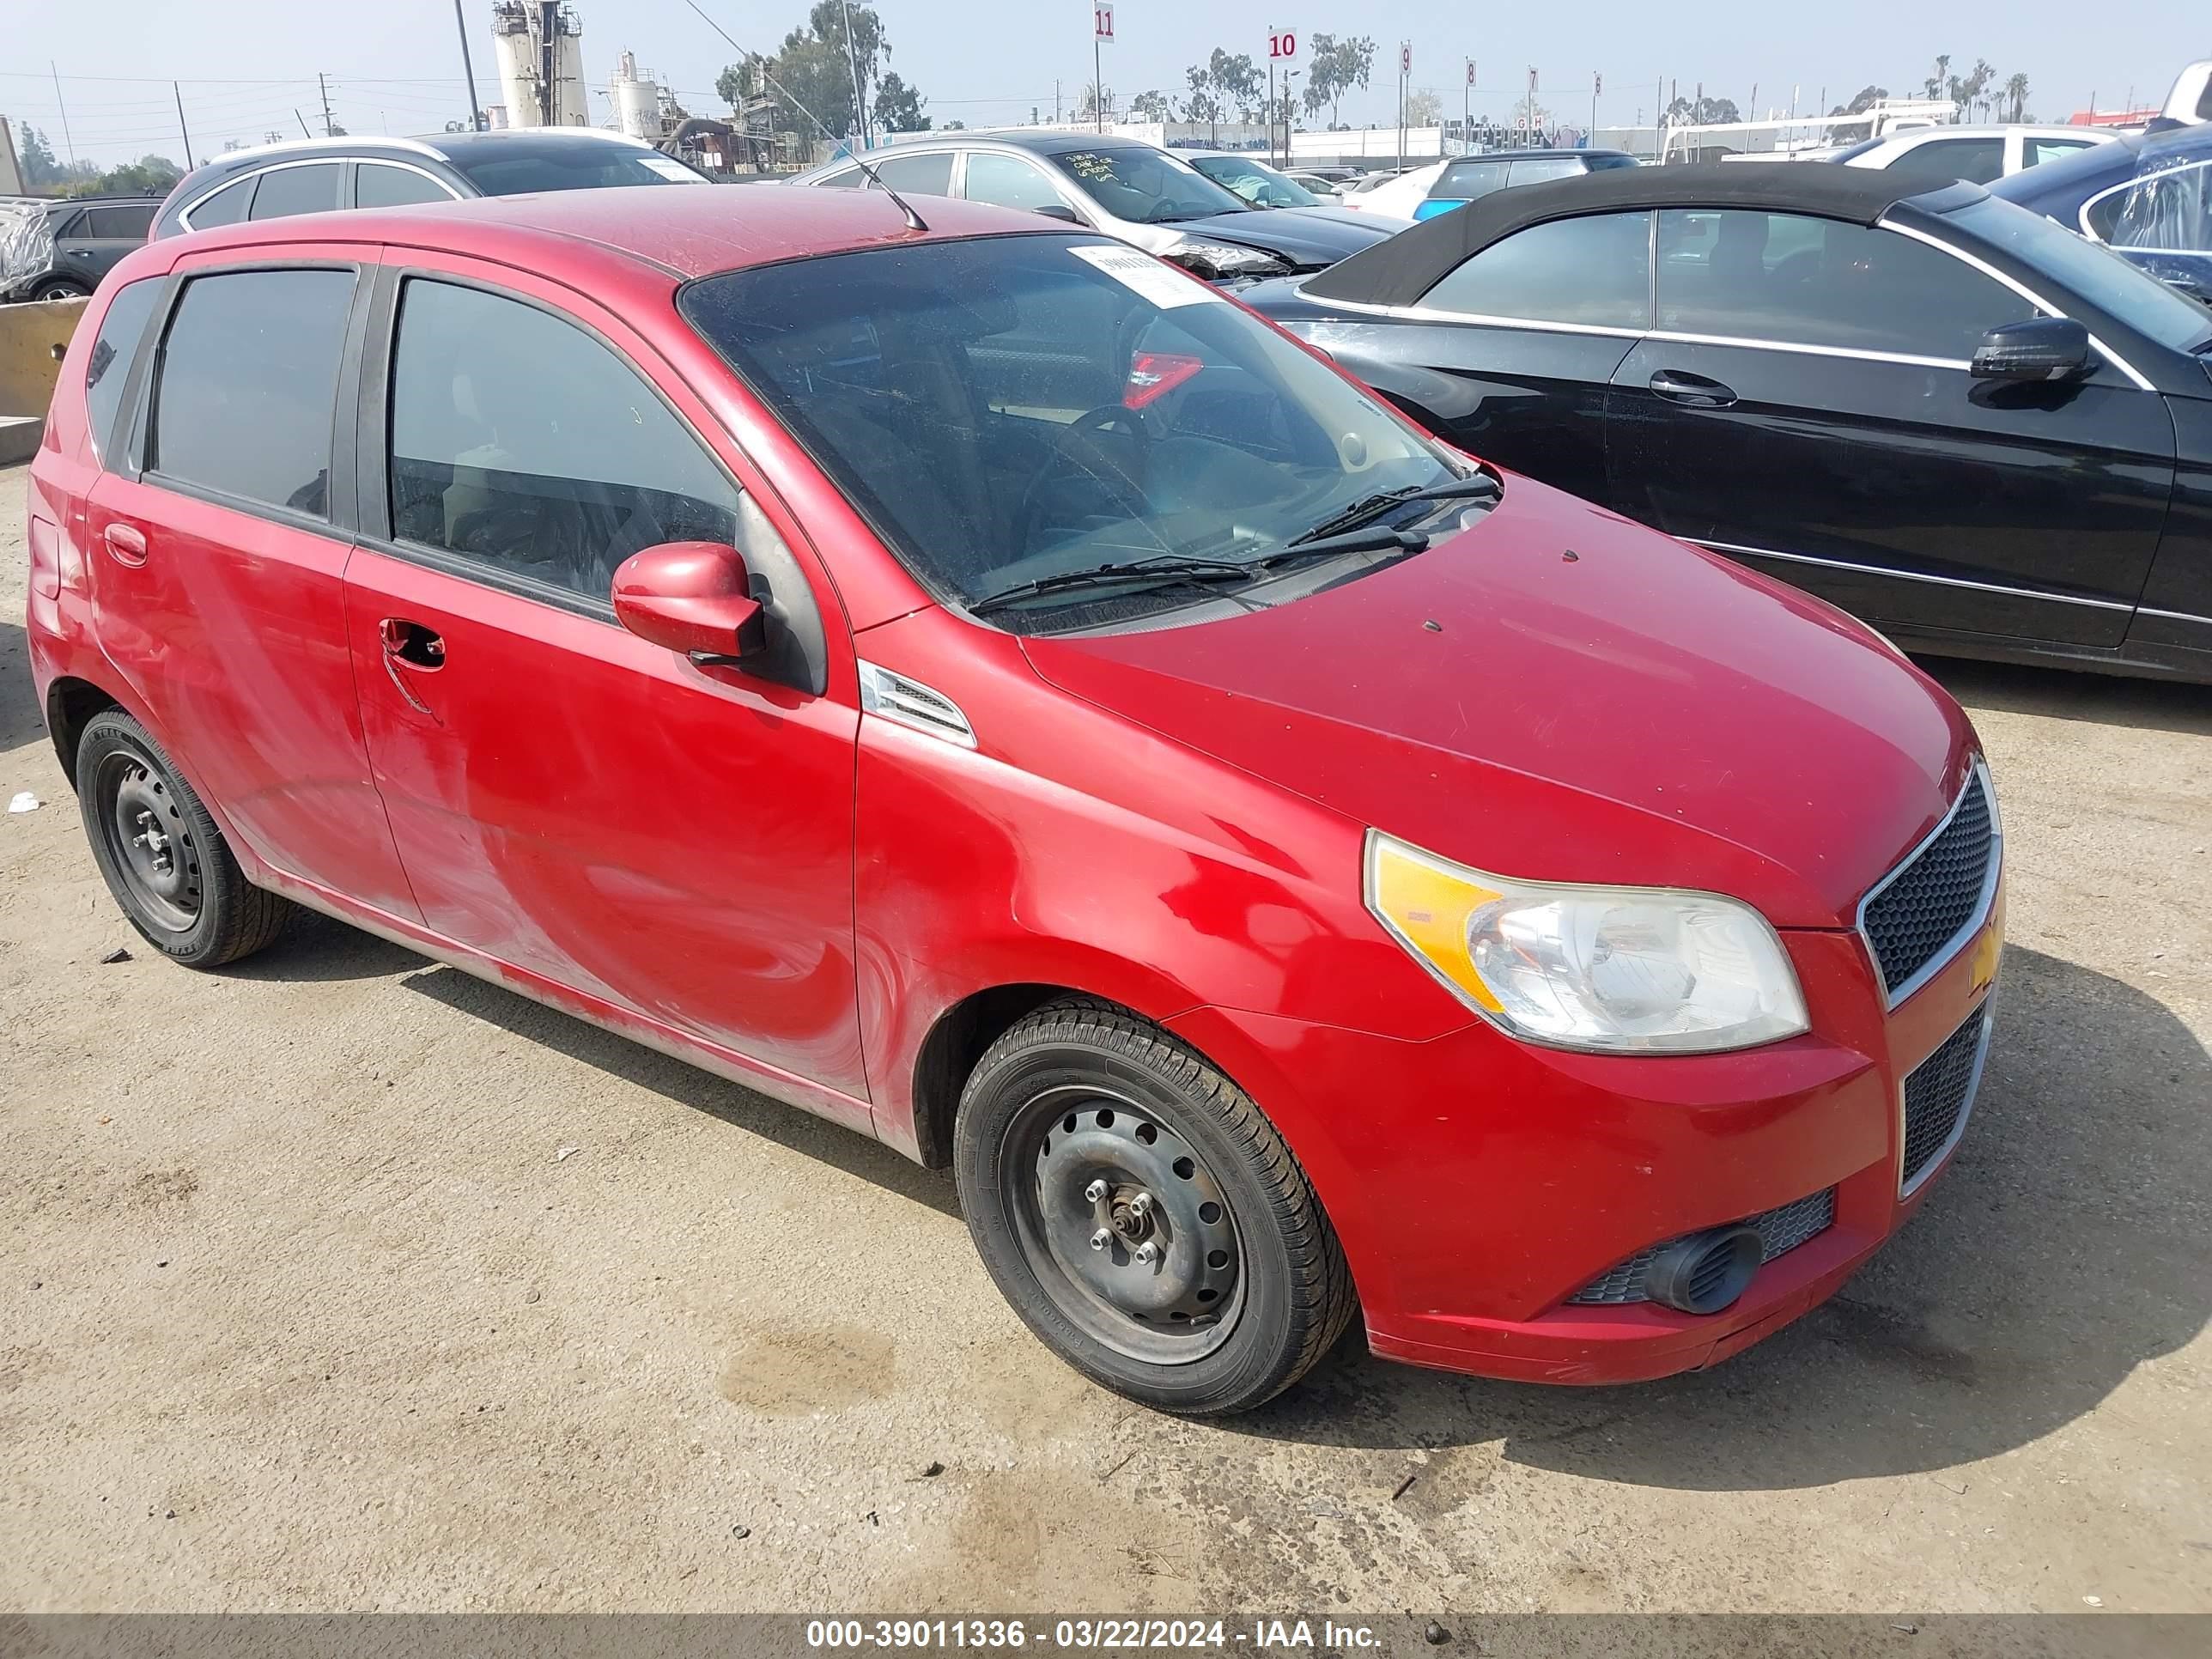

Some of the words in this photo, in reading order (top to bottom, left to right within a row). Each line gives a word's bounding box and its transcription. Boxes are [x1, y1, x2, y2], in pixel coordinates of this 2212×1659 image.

[1095, 9, 1113, 36] 11
[1269, 34, 1295, 57] 10
[1403, 48, 1409, 70] 9
[1468, 64, 1474, 83] 8
[1530, 70, 1536, 89] 7
[1595, 76, 1601, 94] 6
[1517, 118, 1525, 129] G
[1534, 116, 1542, 127] H
